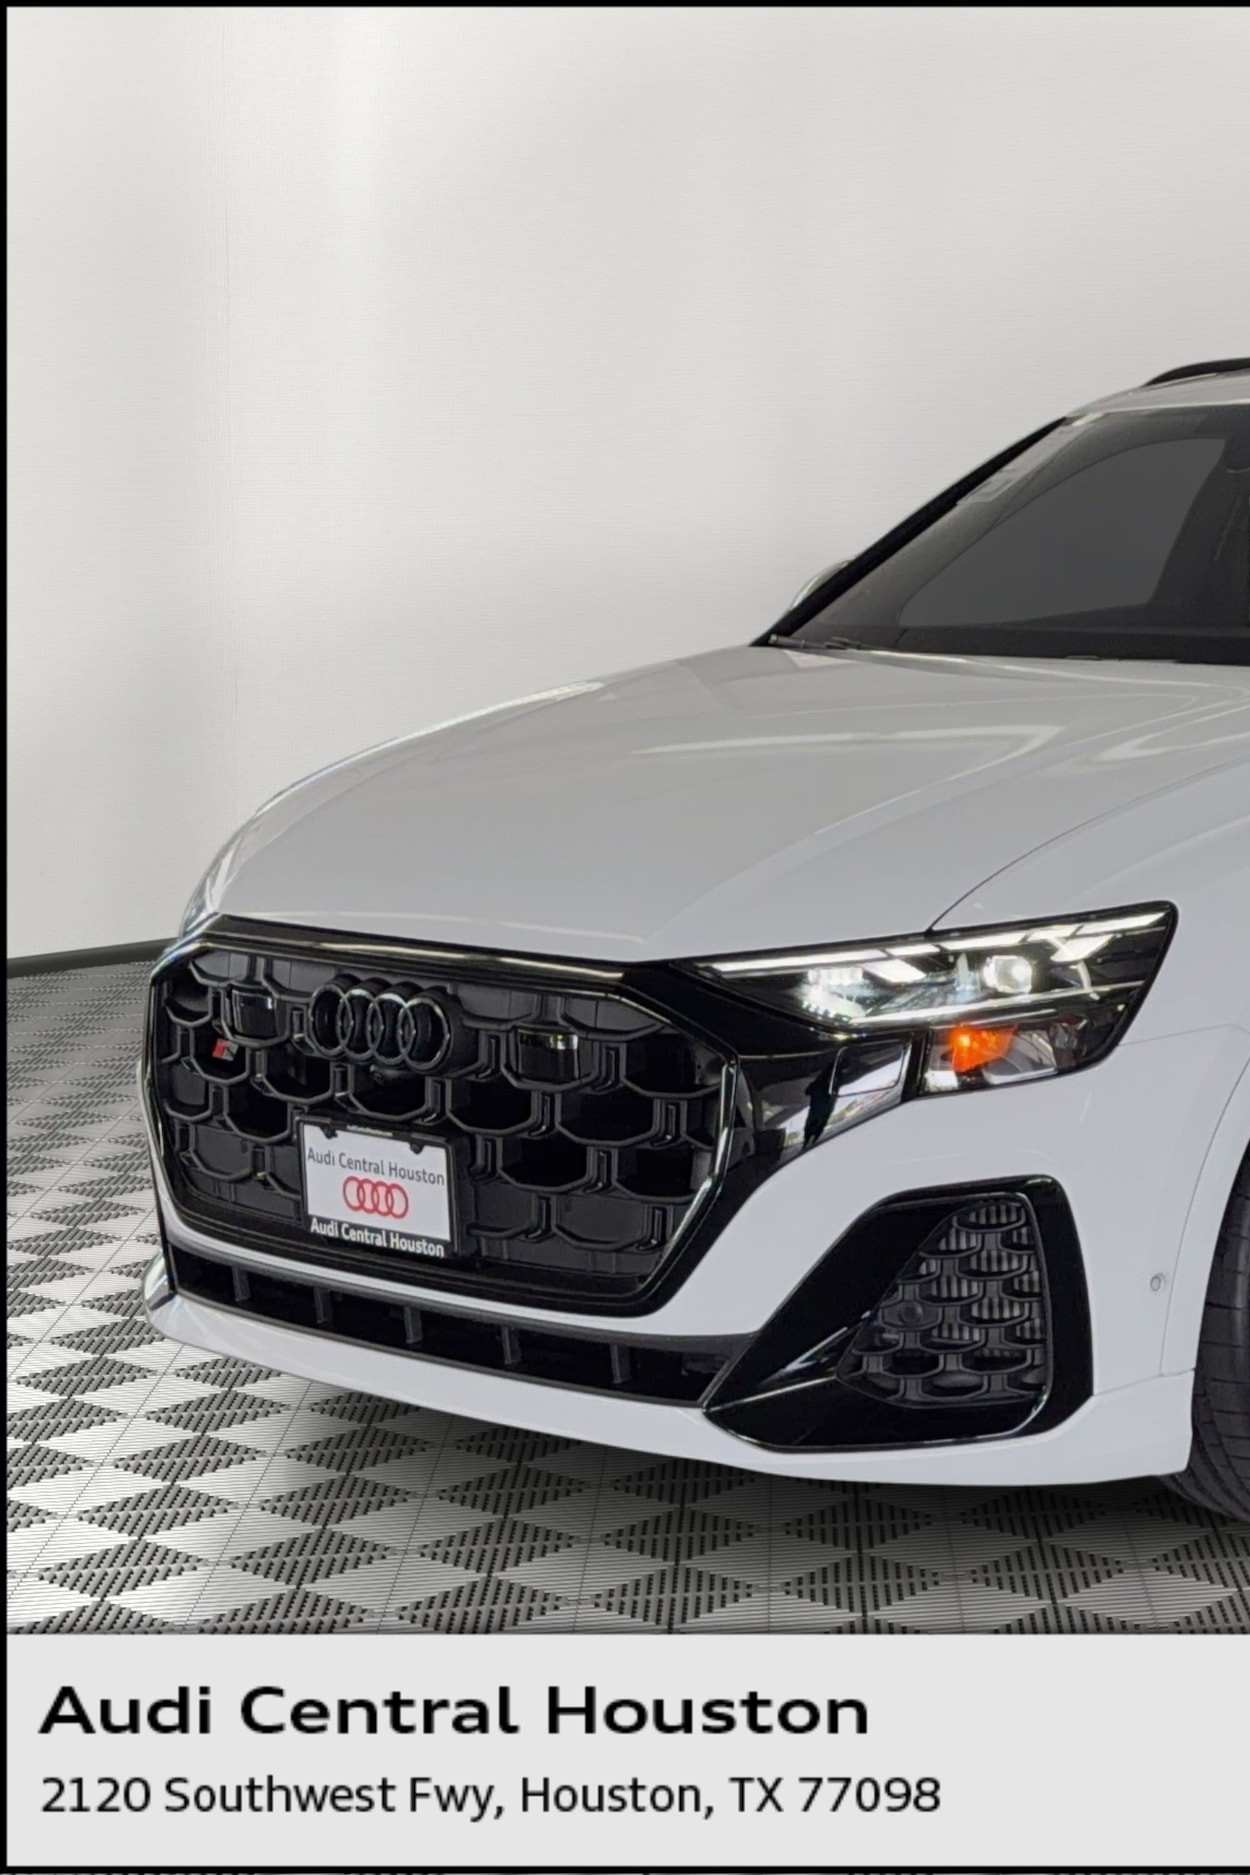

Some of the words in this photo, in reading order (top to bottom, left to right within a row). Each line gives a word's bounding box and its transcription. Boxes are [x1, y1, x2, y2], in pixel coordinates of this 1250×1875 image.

[307, 1147, 335, 1166] Audi
[338, 1153, 385, 1175] Central
[388, 1161, 445, 1186] Houston
[310, 1217, 338, 1237] Audi
[341, 1223, 387, 1249] Central
[390, 1231, 445, 1258] Houston
